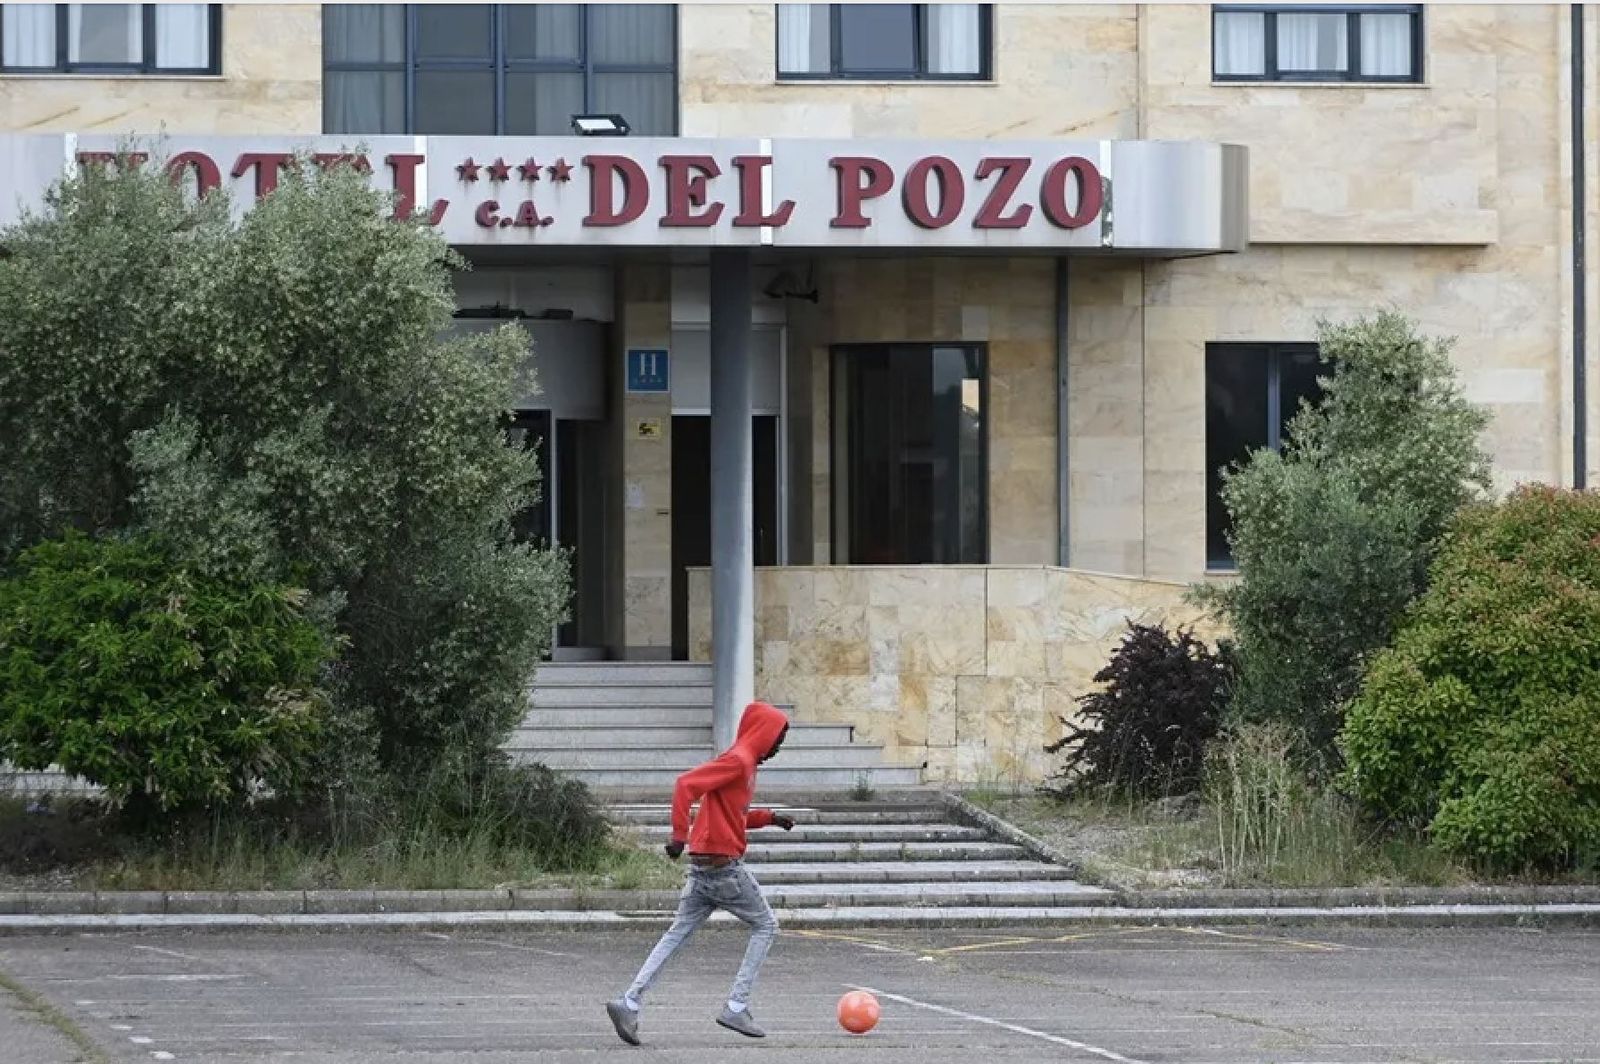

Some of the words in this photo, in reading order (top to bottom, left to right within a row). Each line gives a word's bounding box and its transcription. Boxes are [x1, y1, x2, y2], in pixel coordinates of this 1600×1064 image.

[76, 151, 450, 226] OTL
[581, 155, 796, 228] DEL
[829, 155, 1104, 229] POZO
[475, 200, 554, 228] C.A.
